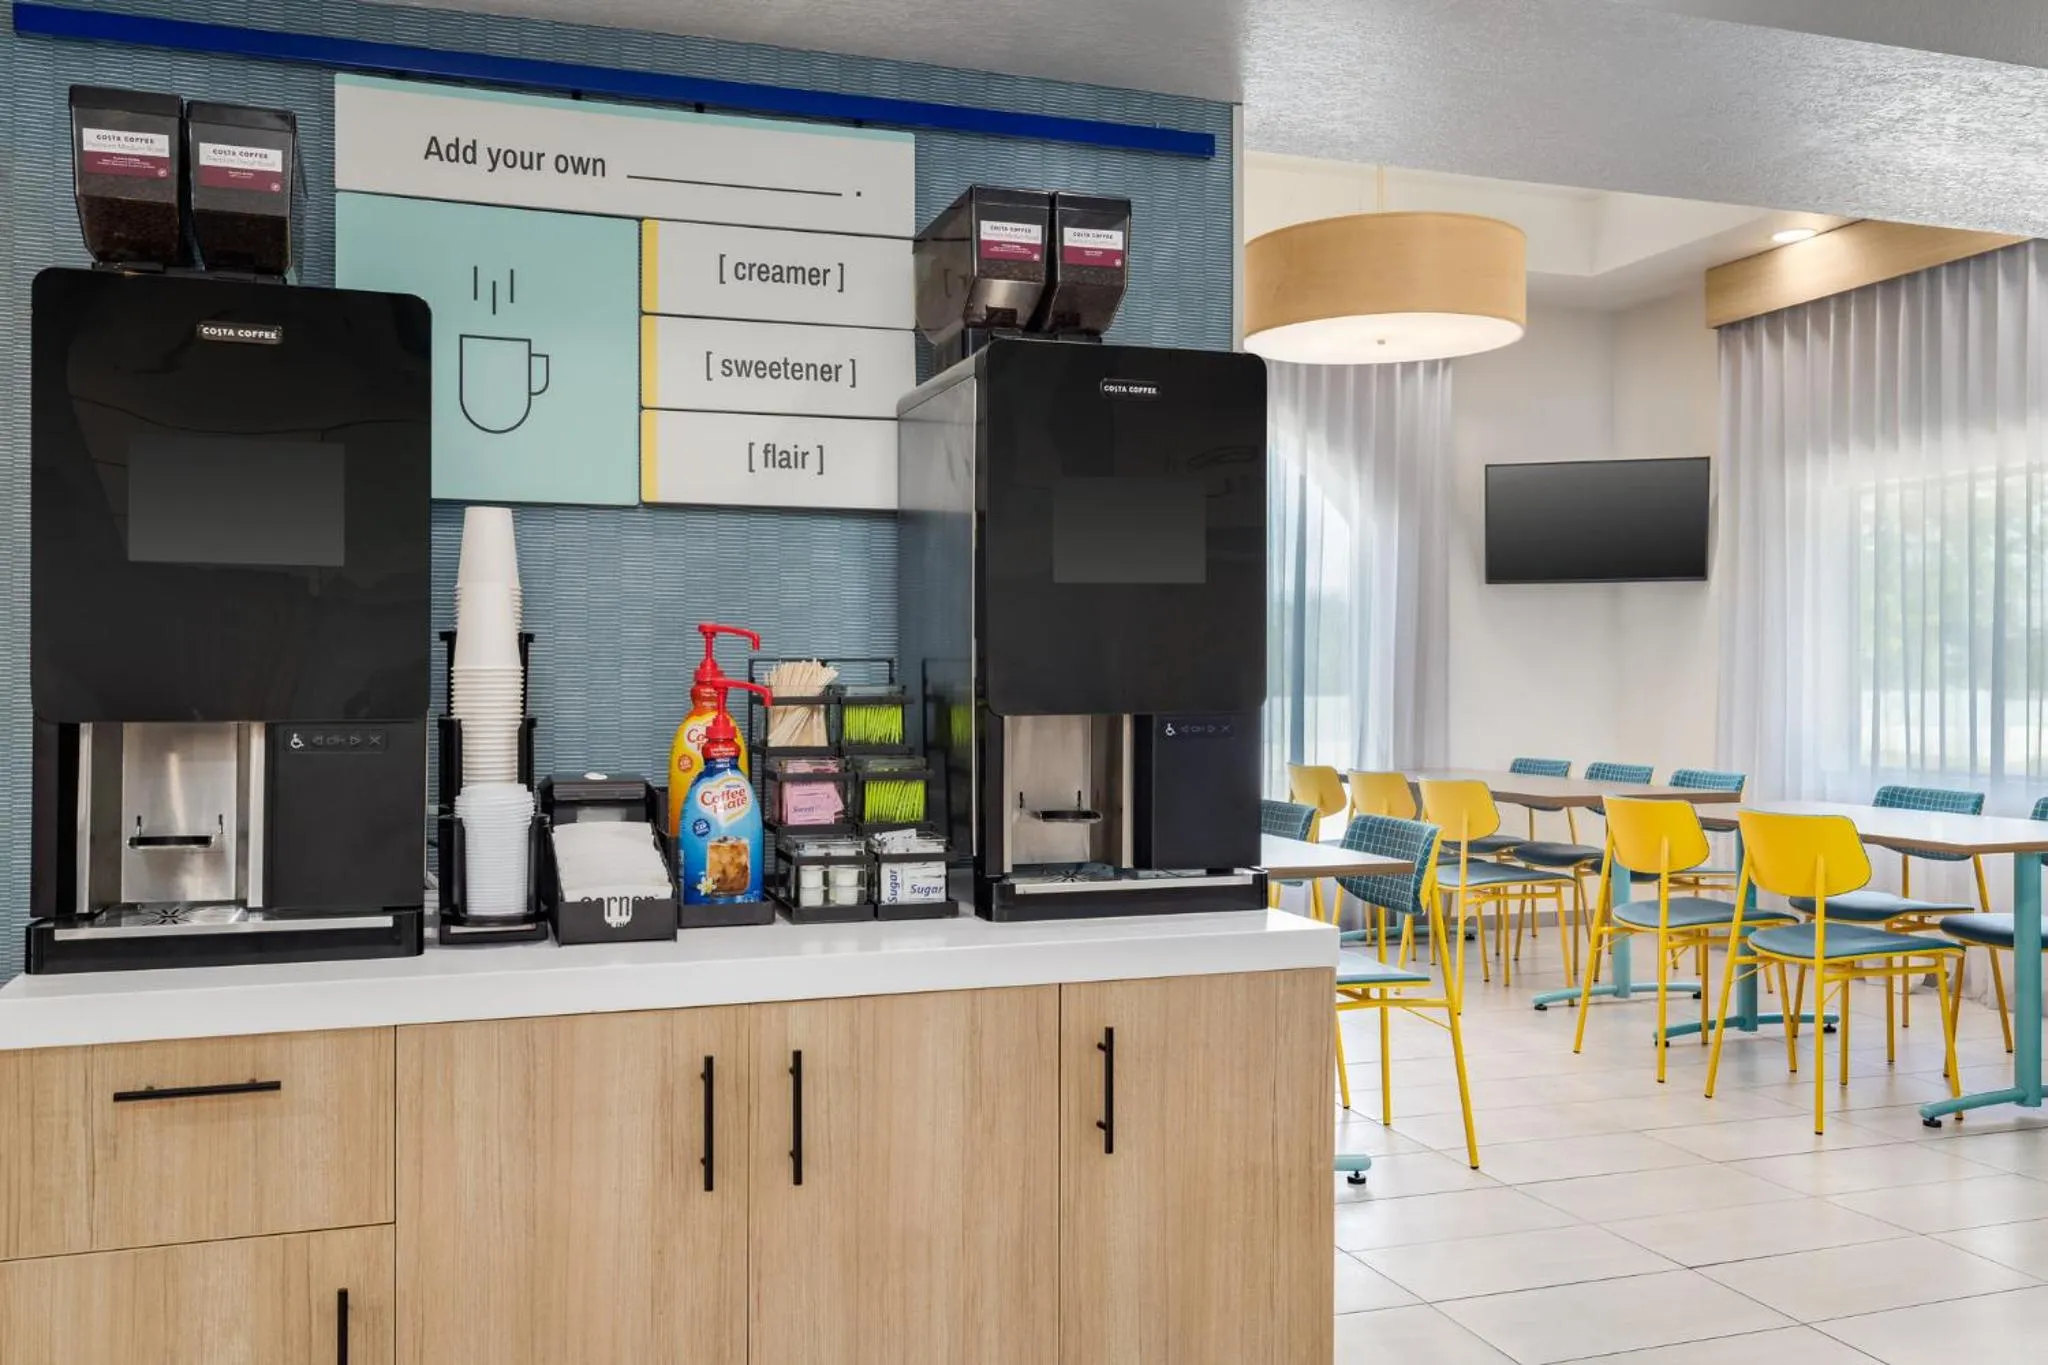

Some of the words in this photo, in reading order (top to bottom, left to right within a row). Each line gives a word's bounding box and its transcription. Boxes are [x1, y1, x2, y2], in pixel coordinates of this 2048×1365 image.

[424, 135, 477, 165] Add
[487, 146, 545, 173] your
[554, 154, 606, 178] own
[202, 326, 235, 337] COSTA
[238, 329, 277, 339] COFFEE
[1103, 384, 1127, 393] COSTA
[1129, 386, 1157, 394] COFFEE
[888, 869, 900, 905] Sugar
[910, 884, 944, 897] Sugar
